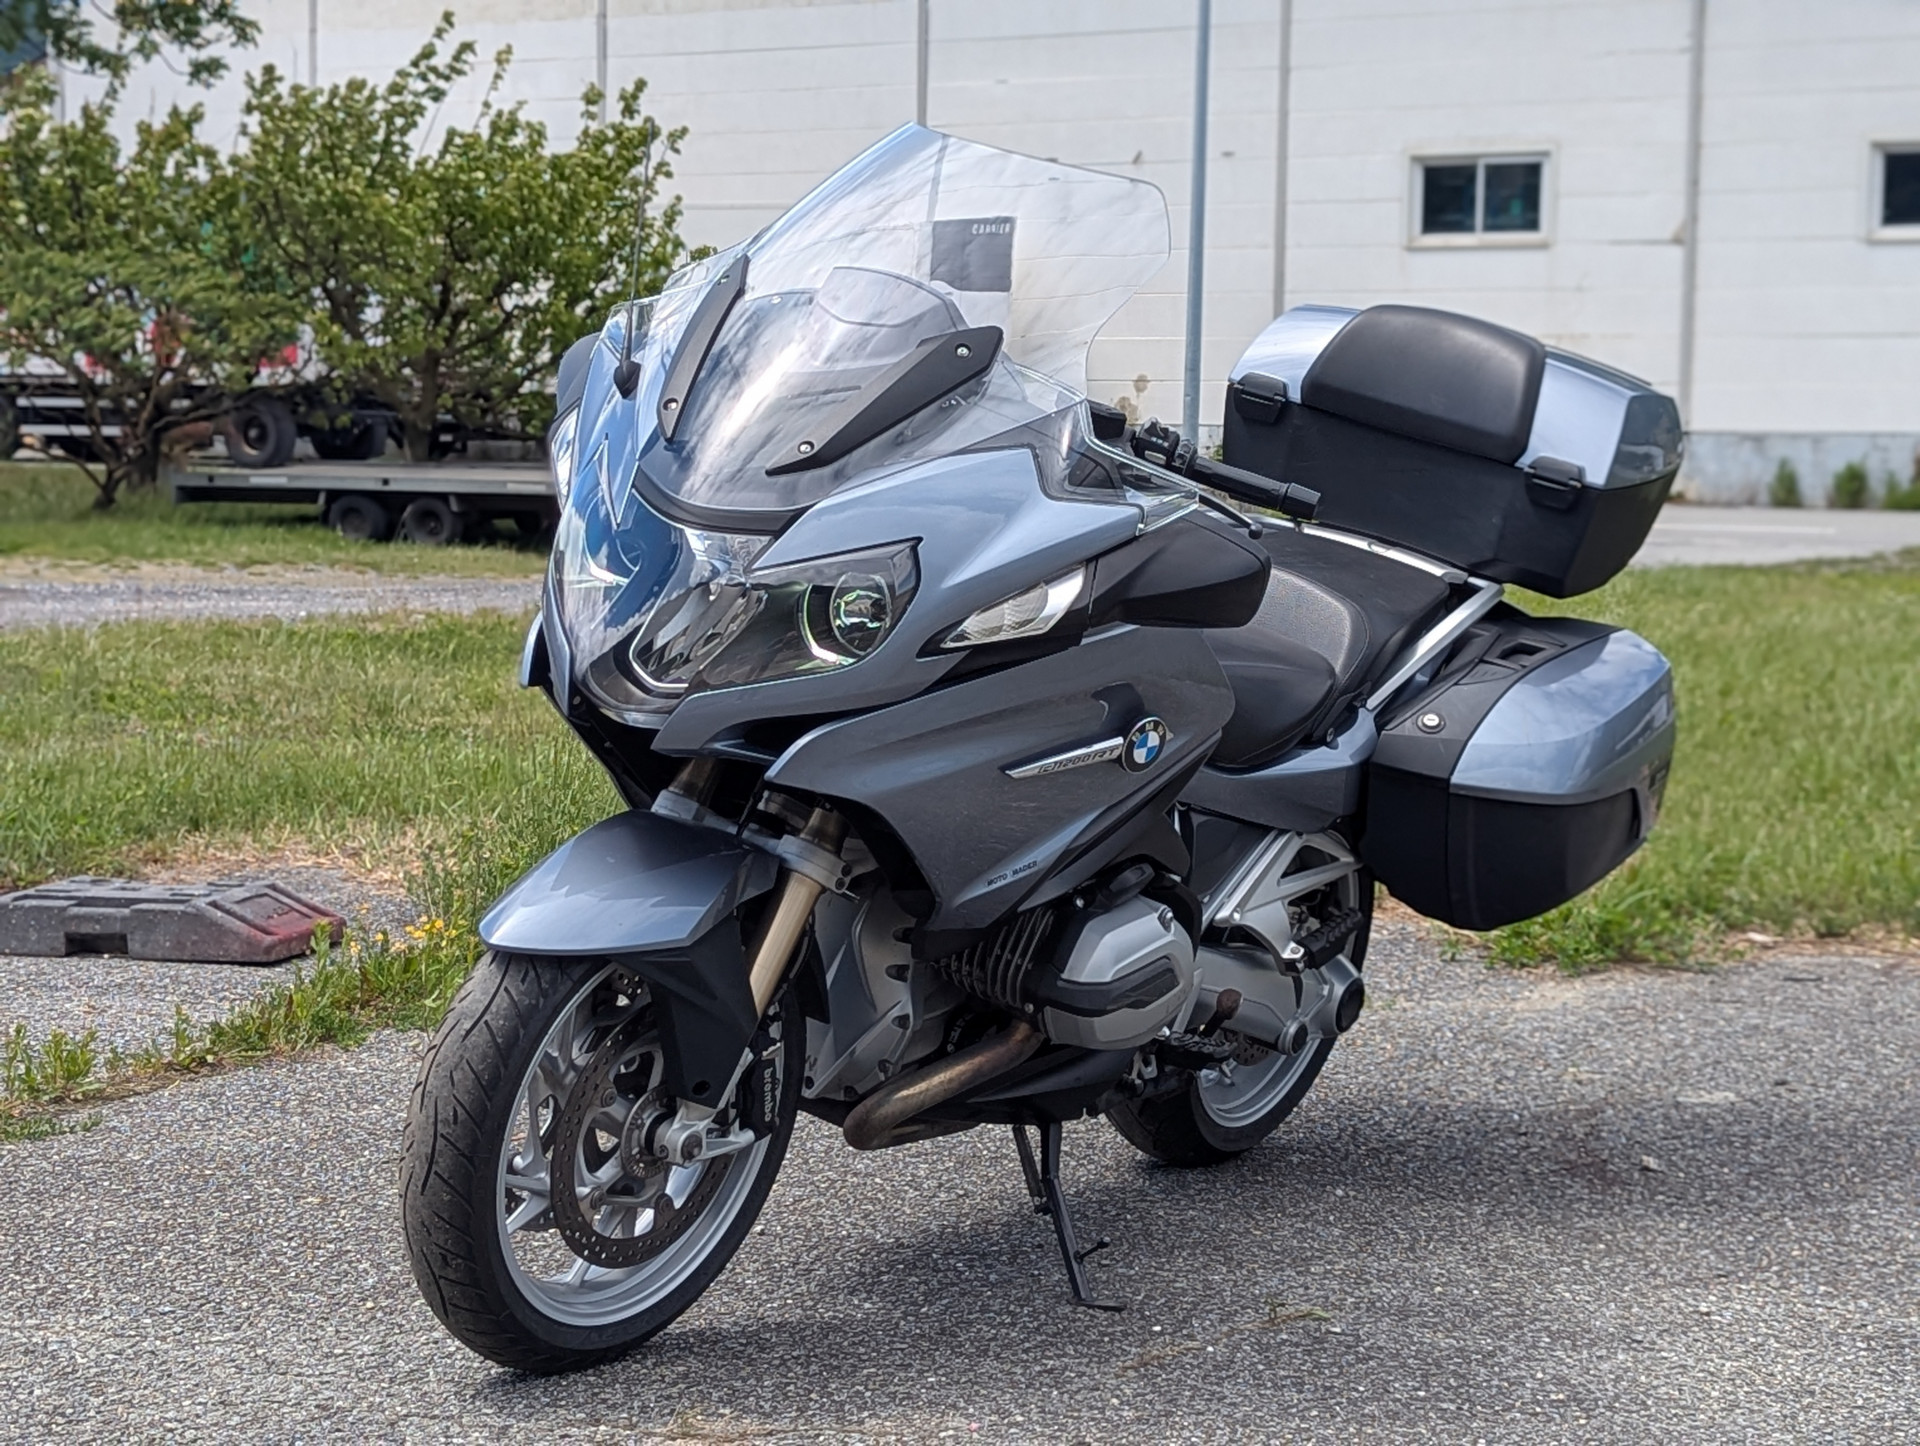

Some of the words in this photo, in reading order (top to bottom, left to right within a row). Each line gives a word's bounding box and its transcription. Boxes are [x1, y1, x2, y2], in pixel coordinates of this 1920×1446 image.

[1131, 722, 1165, 742] BMW
[986, 872, 1008, 887] MOTO
[763, 1066, 774, 1122] brembo
